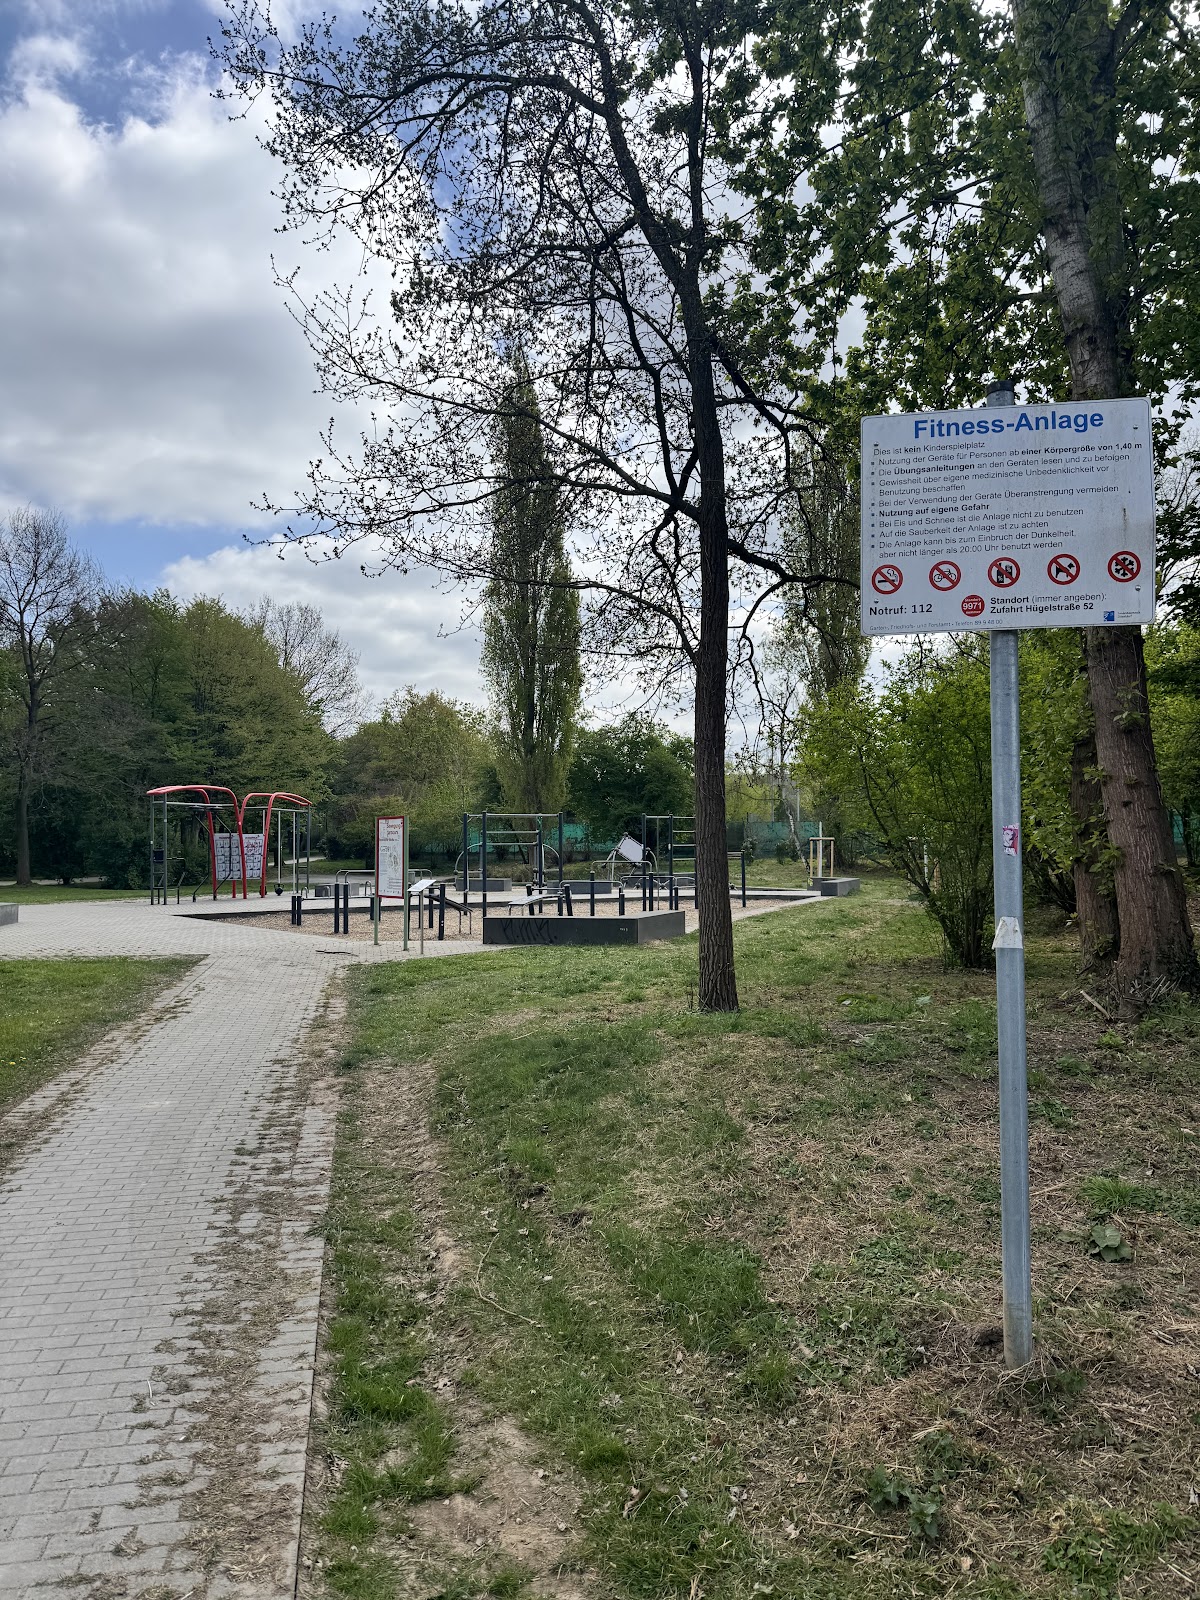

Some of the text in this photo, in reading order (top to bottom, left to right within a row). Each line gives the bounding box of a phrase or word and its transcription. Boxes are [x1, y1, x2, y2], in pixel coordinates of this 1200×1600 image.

[914, 410, 1104, 438] Fitness-Anlage
[924, 442, 985, 452] Kinderspielplatz
[1044, 445, 1095, 454] Körpergröße
[894, 463, 975, 475] Übungsanleitungen
[1007, 458, 1038, 466] Geräten
[1095, 454, 1130, 462] befolgen
[879, 478, 921, 486] Gewissheit
[972, 469, 1023, 479] medizinische
[1026, 466, 1094, 476] Unbedenklichkeit
[879, 484, 965, 496] Benutzung beschaffen
[908, 495, 957, 505] Verwendung
[1005, 489, 1074, 498] Überanstrengung
[931, 506, 959, 514] eigene
[982, 513, 1010, 521] Anlage
[909, 526, 950, 536] Sauberkeit
[968, 524, 996, 532] Anlage
[894, 539, 921, 548] Anlage
[978, 534, 1013, 542] Einbruch
[920, 548, 943, 557] länger
[990, 592, 1106, 604] Standort (immer angeben):
[870, 604, 932, 615] Notruf: 112
[963, 601, 982, 610] 9971
[990, 606, 1023, 614] Zufahrt
[1026, 603, 1080, 613] Hügelstraße
